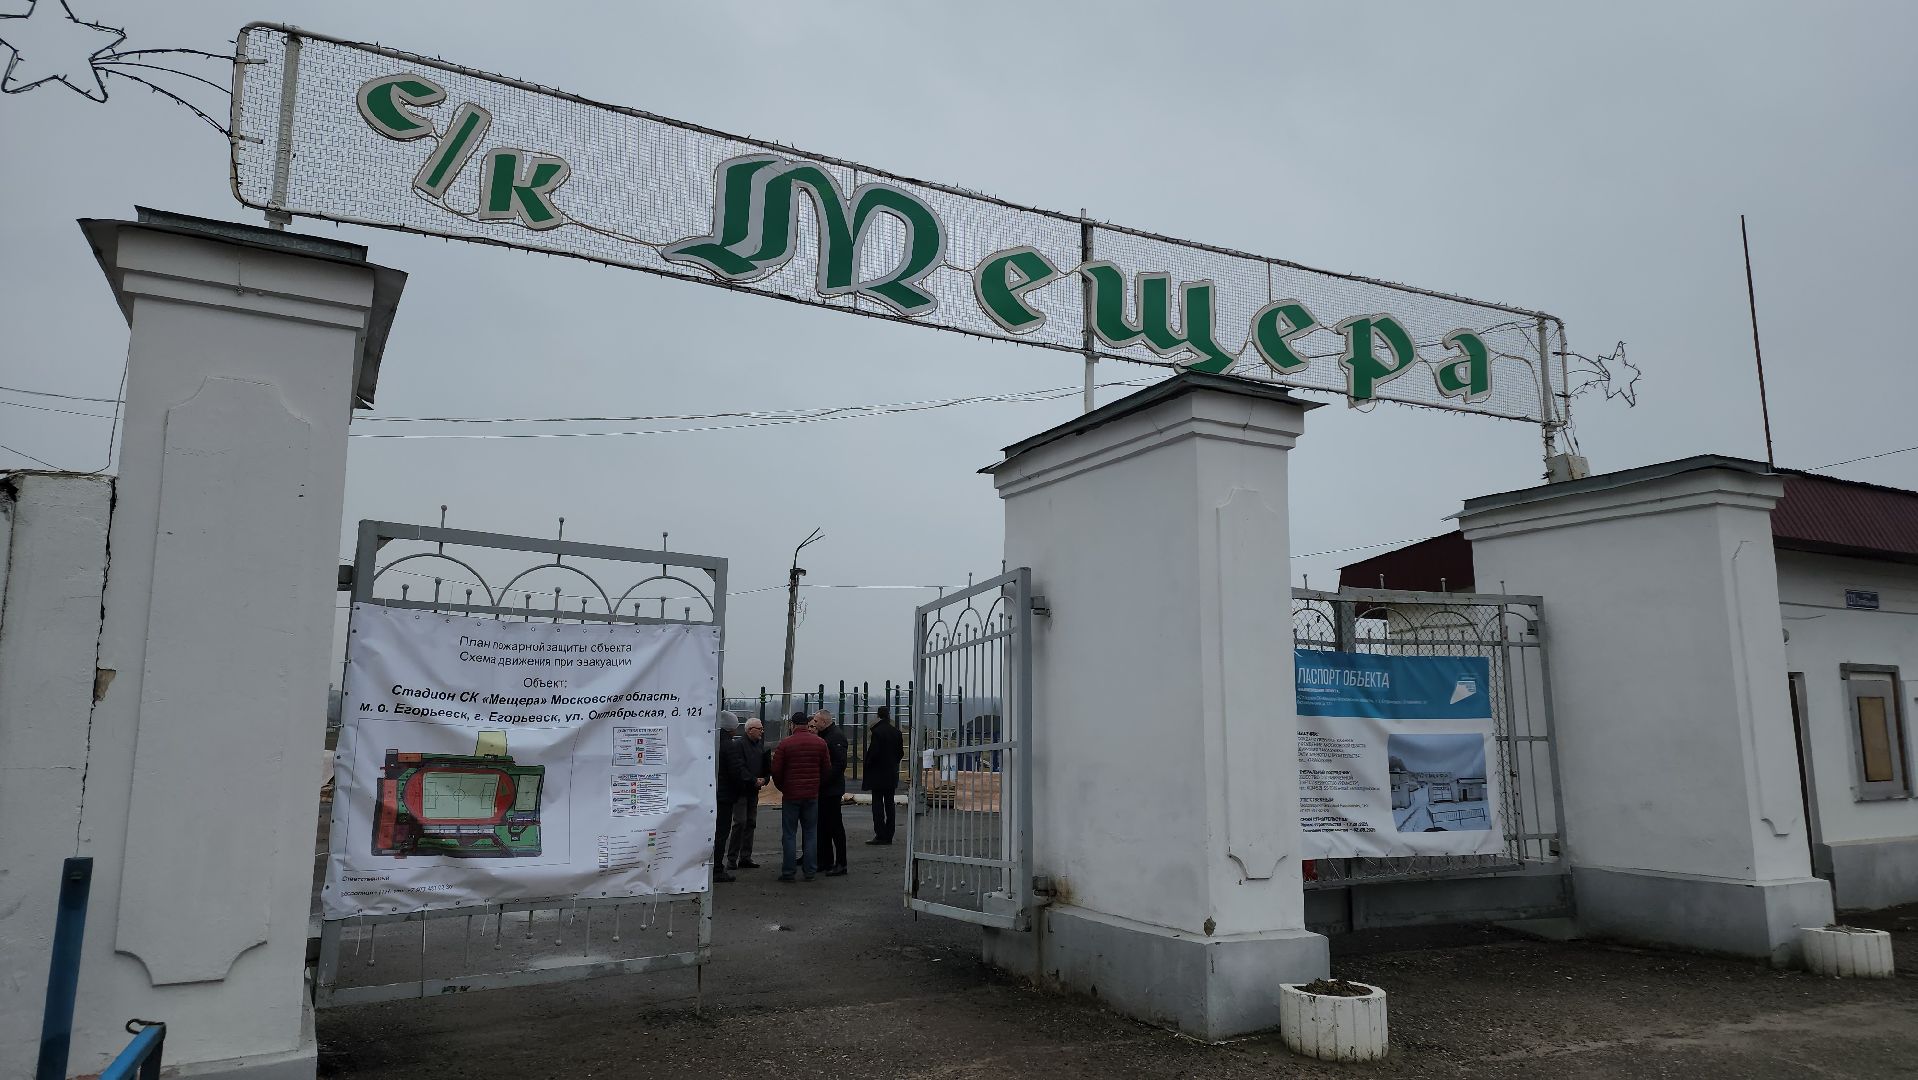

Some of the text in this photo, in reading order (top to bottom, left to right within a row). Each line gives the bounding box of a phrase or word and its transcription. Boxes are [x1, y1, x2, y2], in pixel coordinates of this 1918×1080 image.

[662, 153, 1494, 410] Мещера
[459, 635, 632, 654] План пожарной защиты объекта
[459, 651, 632, 669] Схема движения при эвакуации
[523, 677, 568, 688] Объект:
[1297, 667, 1390, 689] ПАСПОРТ ОБЪЕКТА
[391, 684, 680, 707] Стадион СК «Мещера» Московская область,
[359, 703, 702, 724] м. о. Егорьевск, г. Егорьевск, ул. Октябрьская, д. 121
